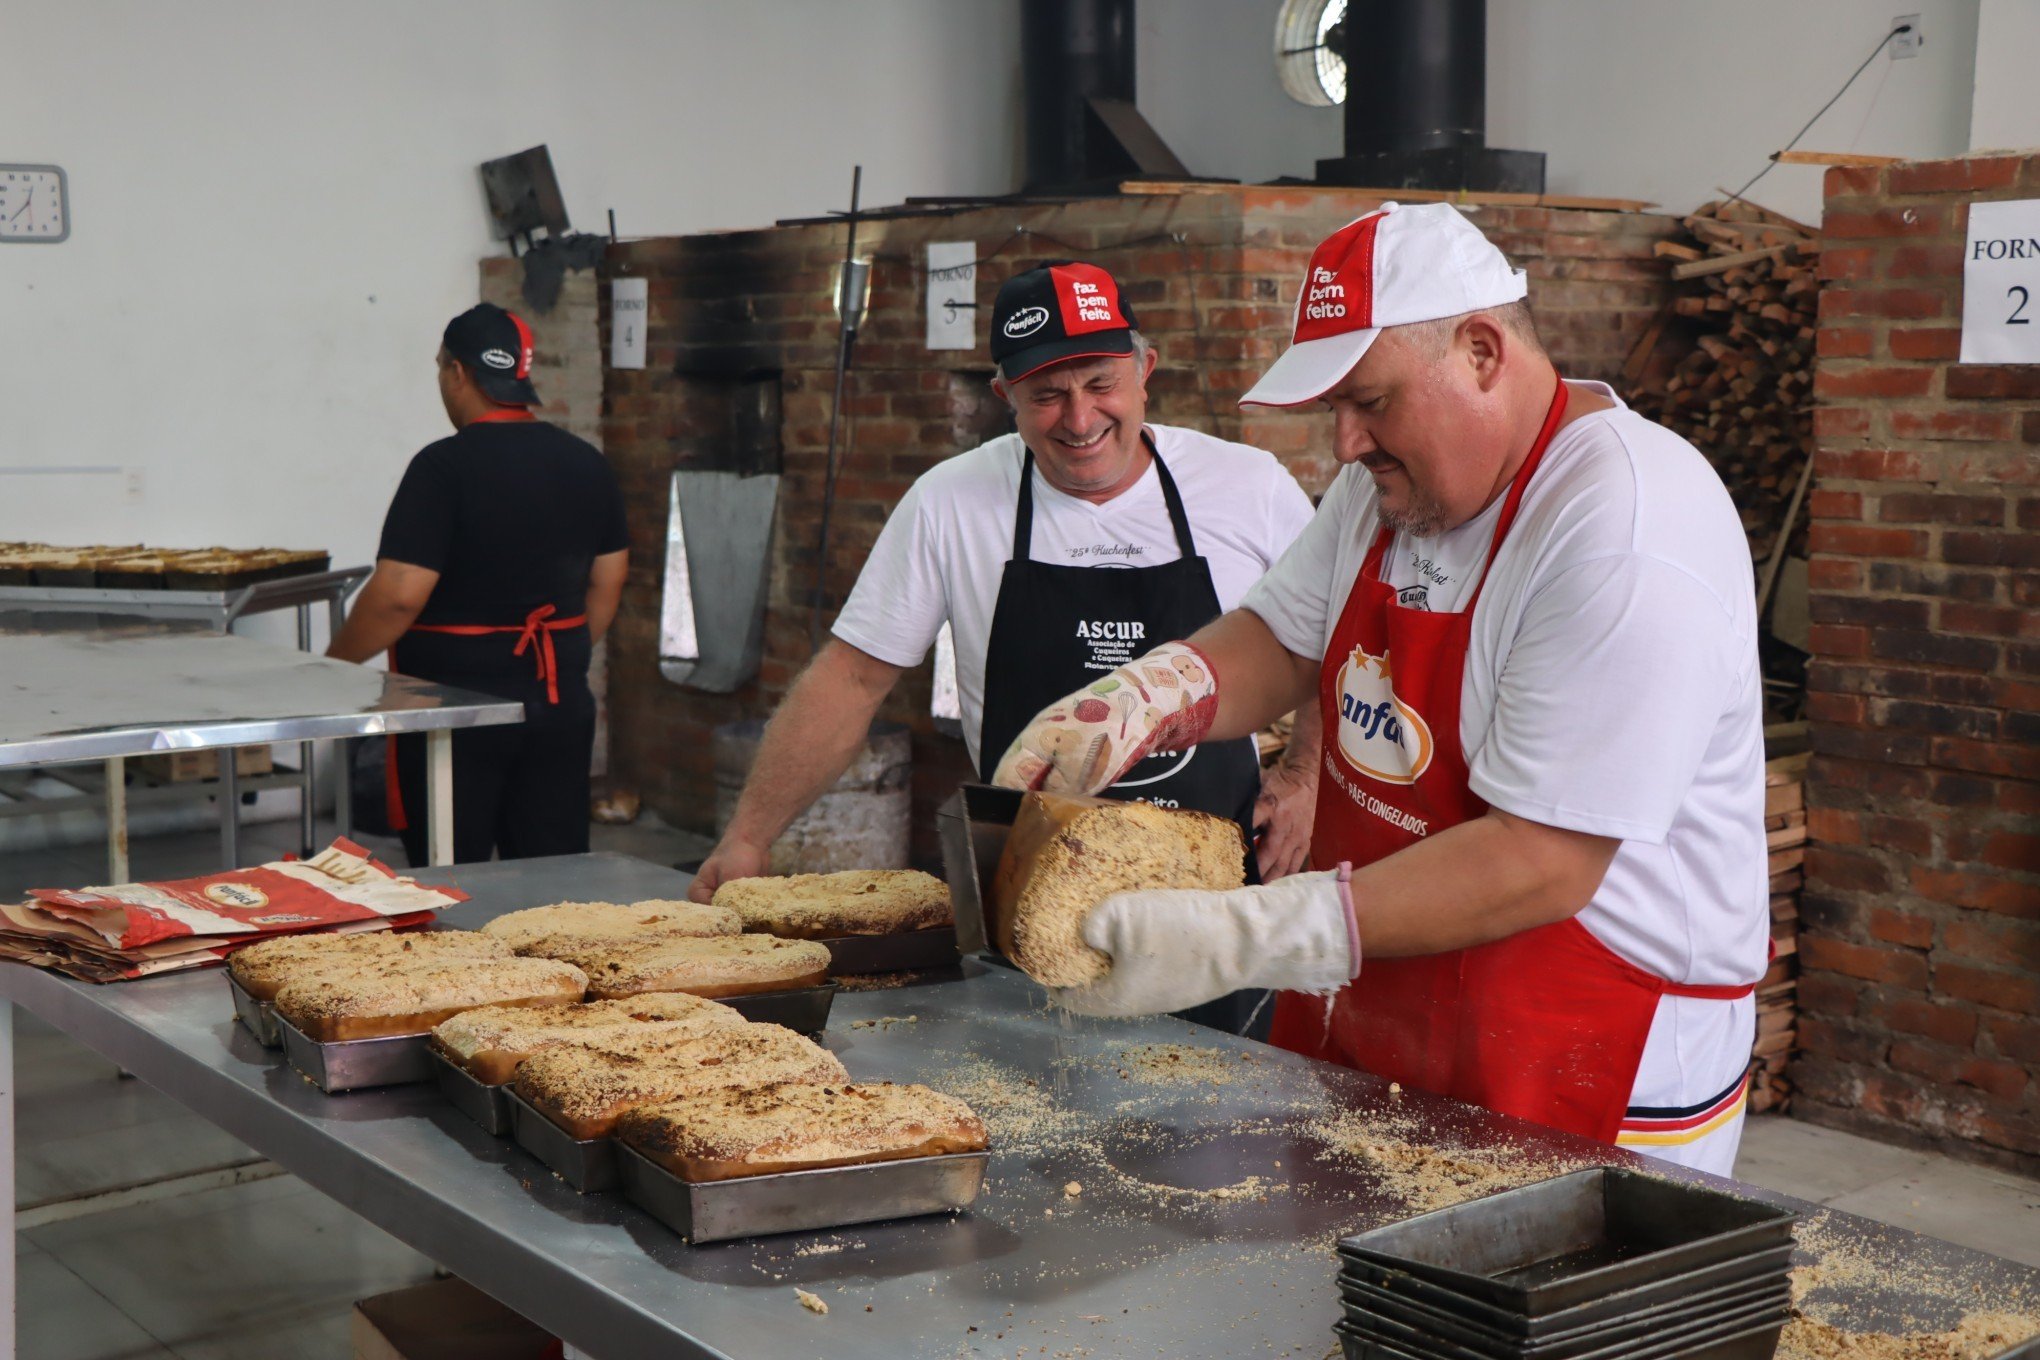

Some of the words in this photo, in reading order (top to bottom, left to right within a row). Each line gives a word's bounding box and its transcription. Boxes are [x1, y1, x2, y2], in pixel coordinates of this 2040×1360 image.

[1073, 282, 1098, 294] faz
[1076, 295, 1108, 308] bem
[1306, 301, 1346, 320] feito
[2005, 285, 2030, 325] 2
[945, 298, 957, 325] 3
[1079, 307, 1111, 321] feito
[1008, 311, 1042, 333] Panfácil
[625, 325, 634, 348] 4
[1092, 543, 1143, 559] Kuchenfest
[1076, 619, 1146, 640] ASCUR
[1087, 639, 1126, 649] Associação
[1126, 640, 1136, 648] de
[1093, 647, 1130, 656] Cuqueiros
[1348, 782, 1367, 808] PÃES
[1367, 796, 1428, 838] CONGELADOS
